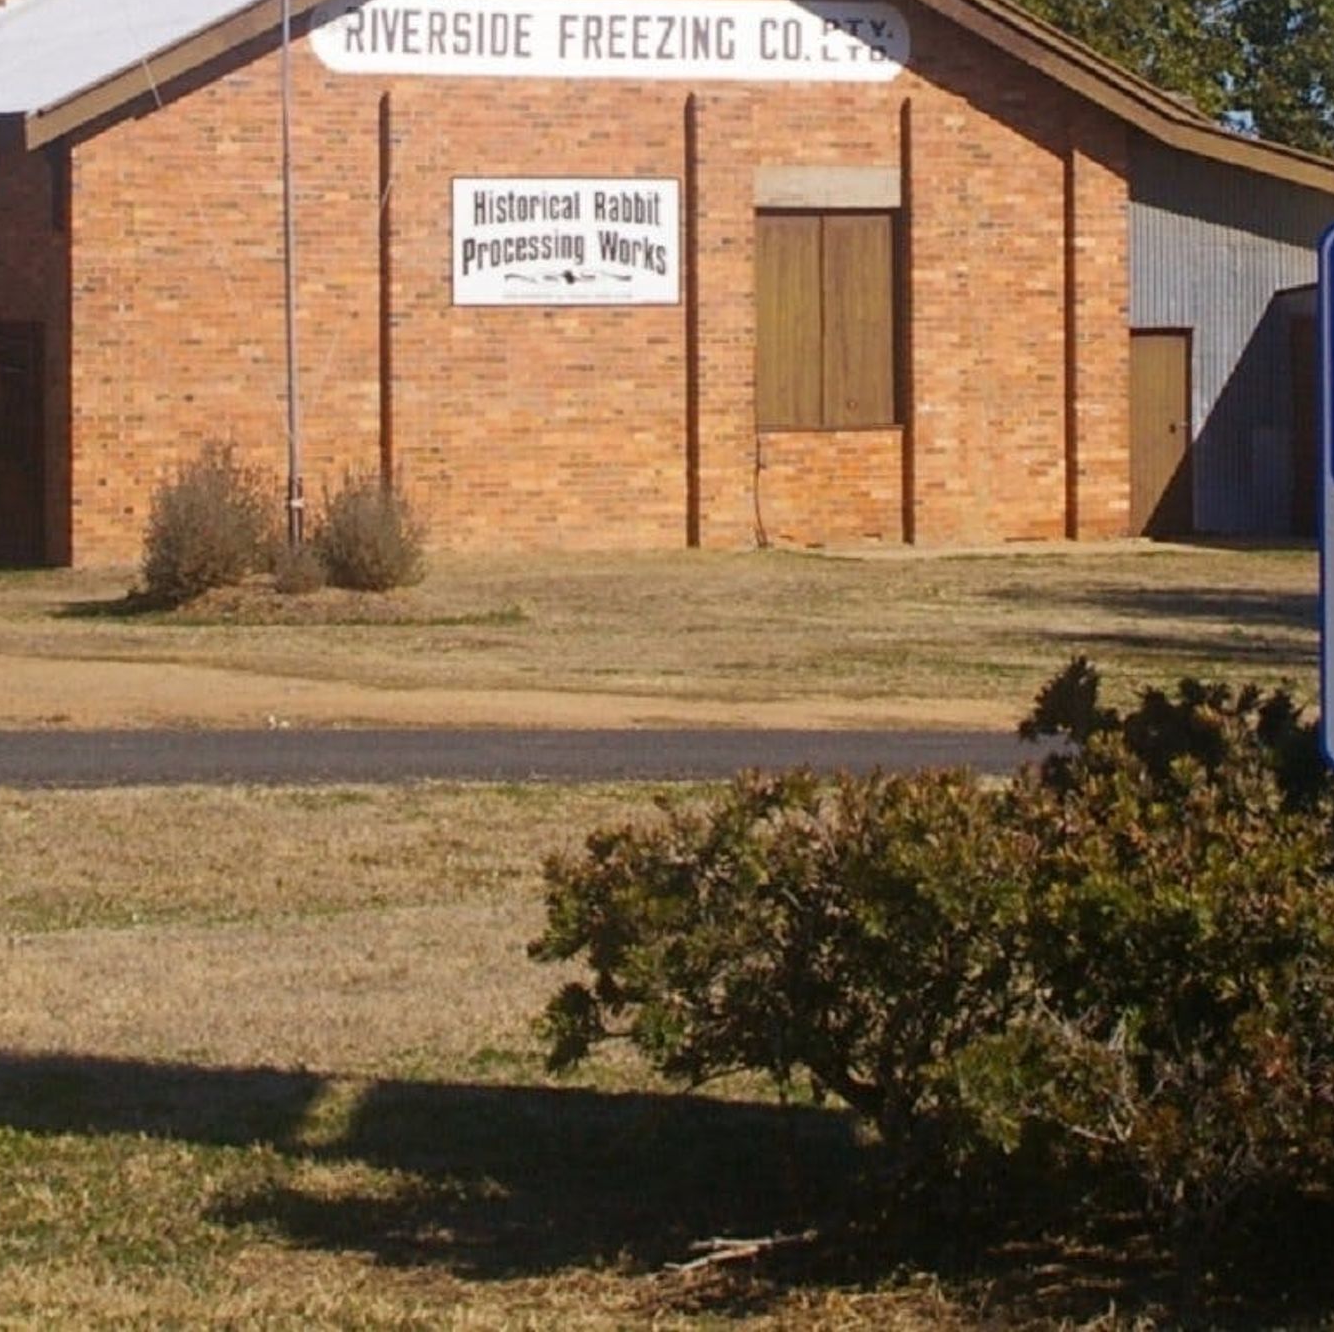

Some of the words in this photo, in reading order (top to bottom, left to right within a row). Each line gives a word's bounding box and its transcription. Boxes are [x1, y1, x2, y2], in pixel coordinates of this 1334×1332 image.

[345, 7, 532, 57] RIVERSIDE
[560, 15, 735, 60] FREEZING
[760, 19, 811, 61] CO.
[823, 19, 893, 38] PTY.
[474, 191, 580, 226] Historical
[595, 192, 661, 226] Rabbit
[463, 230, 584, 276] Processing
[598, 231, 666, 275] Works
